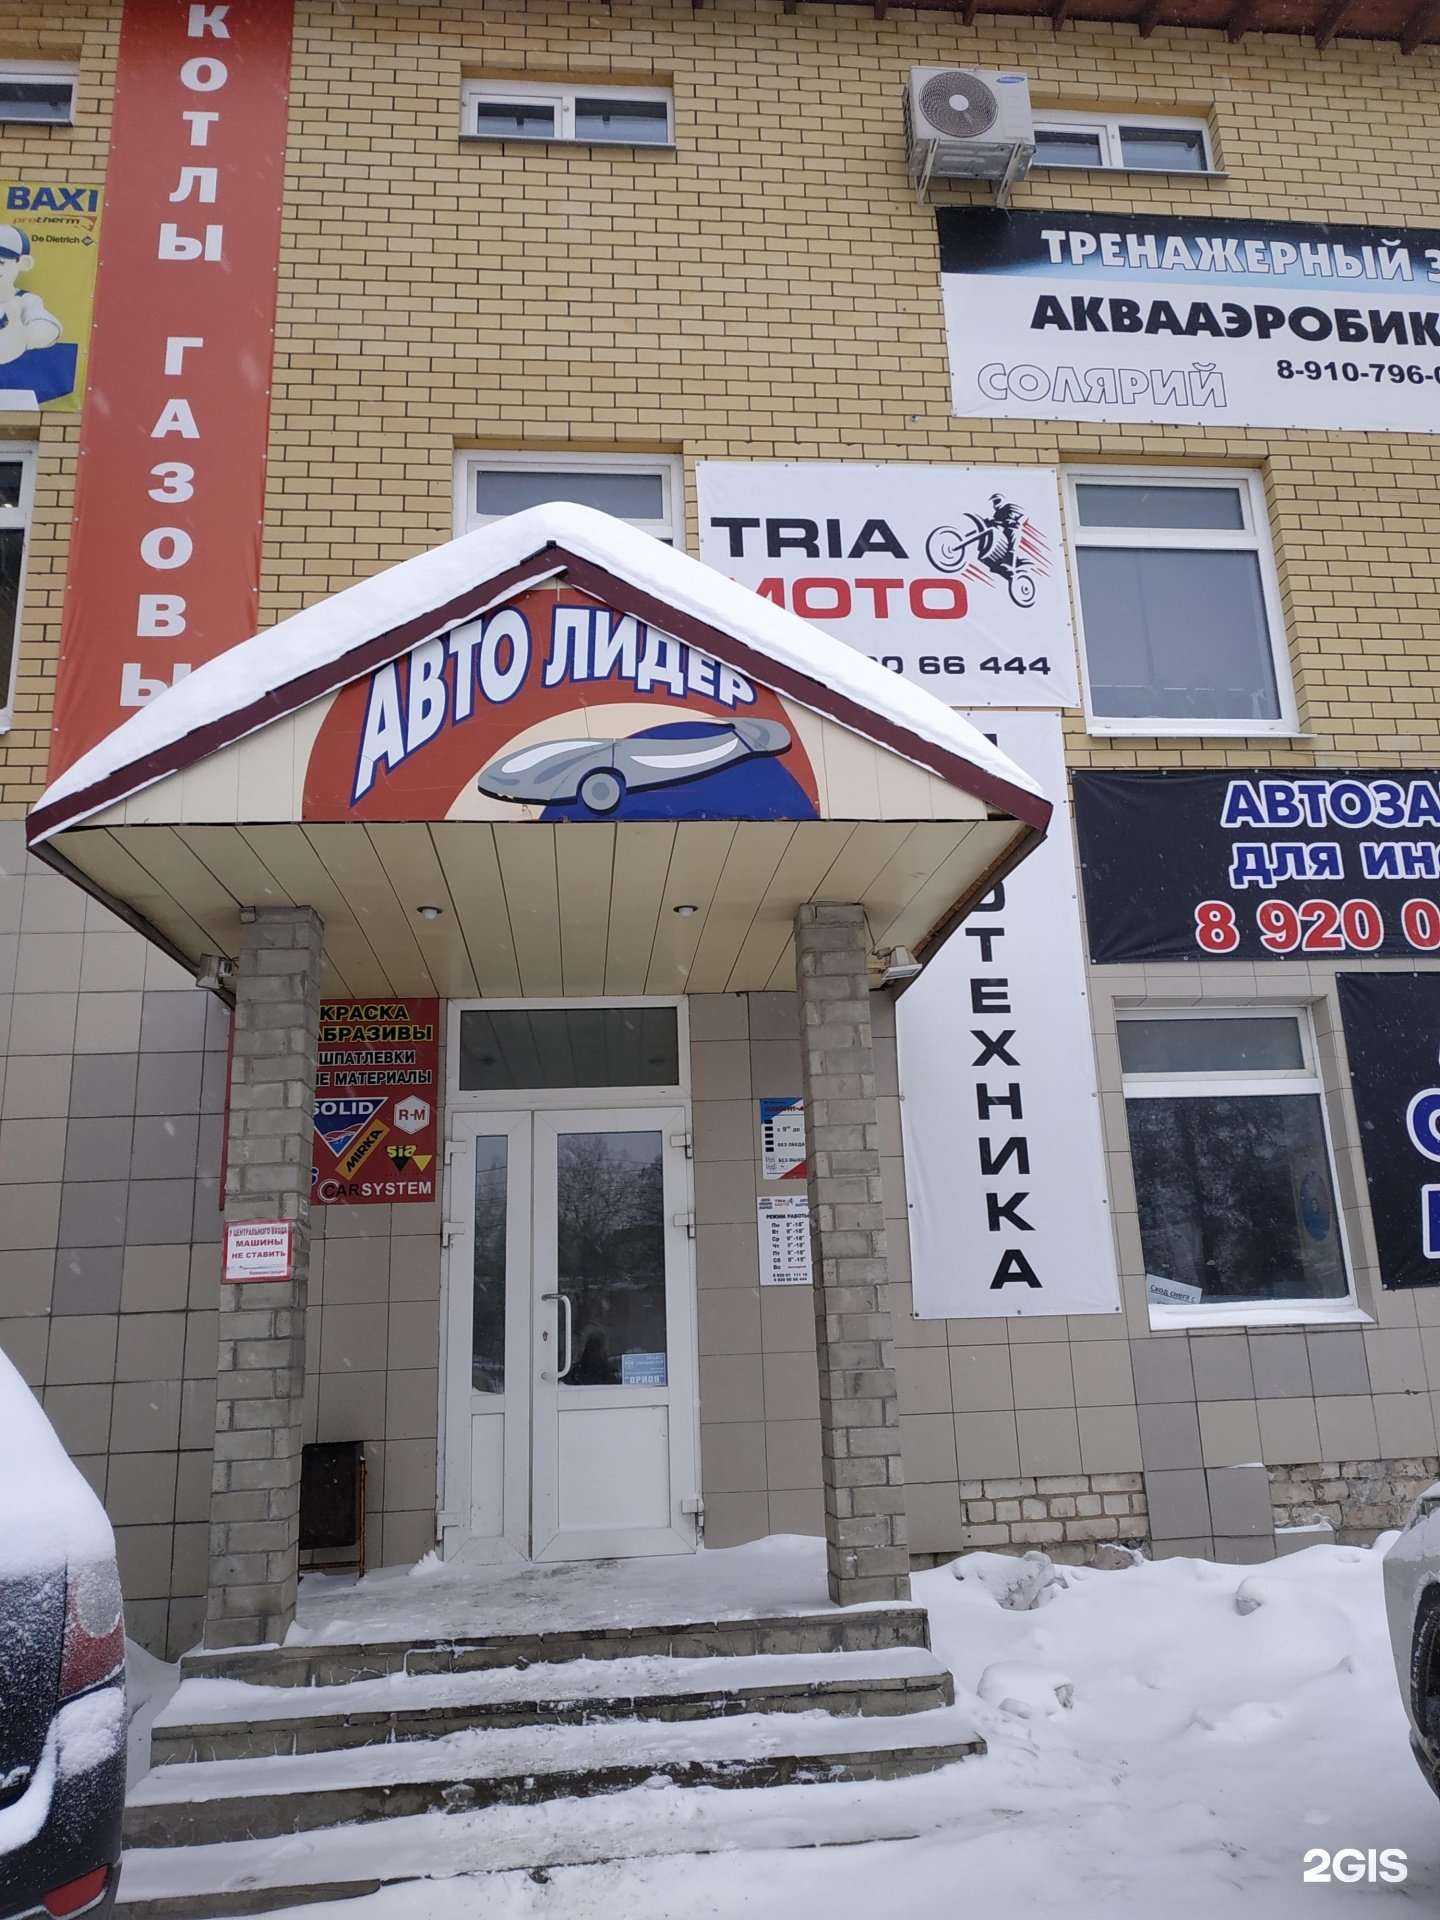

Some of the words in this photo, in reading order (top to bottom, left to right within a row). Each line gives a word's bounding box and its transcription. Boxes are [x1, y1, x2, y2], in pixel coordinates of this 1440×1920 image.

[157, 4, 230, 261] КОТЛЫ
[6, 186, 99, 212] BAXI
[31, 234, 44, 242] De
[45, 235, 80, 244] Dietrich
[1040, 229, 1414, 282] ТРЕНАЖЕРНЫЙ
[977, 362, 1228, 408] СОЛЯРИЙ
[710, 516, 909, 560] TRIA
[918, 656, 965, 675] 66
[979, 656, 1052, 676] 444
[350, 604, 532, 807] АВТО
[541, 602, 757, 708] ЛИДЕР
[1194, 900, 1241, 954] 8
[1256, 897, 1384, 951] 920
[317, 1024, 433, 1043] БРАЗИВЫ
[318, 1049, 416, 1067] ШПАТЛЕВКИ
[334, 1069, 432, 1087] МАТЕРИАЛЫ
[398, 1109, 425, 1121] R-M
[345, 1129, 384, 1172] MIRKA
[386, 1145, 417, 1158] sia
[236, 1238, 283, 1247] МАШИНЫ
[246, 1250, 286, 1259] СТАВИТЬ
